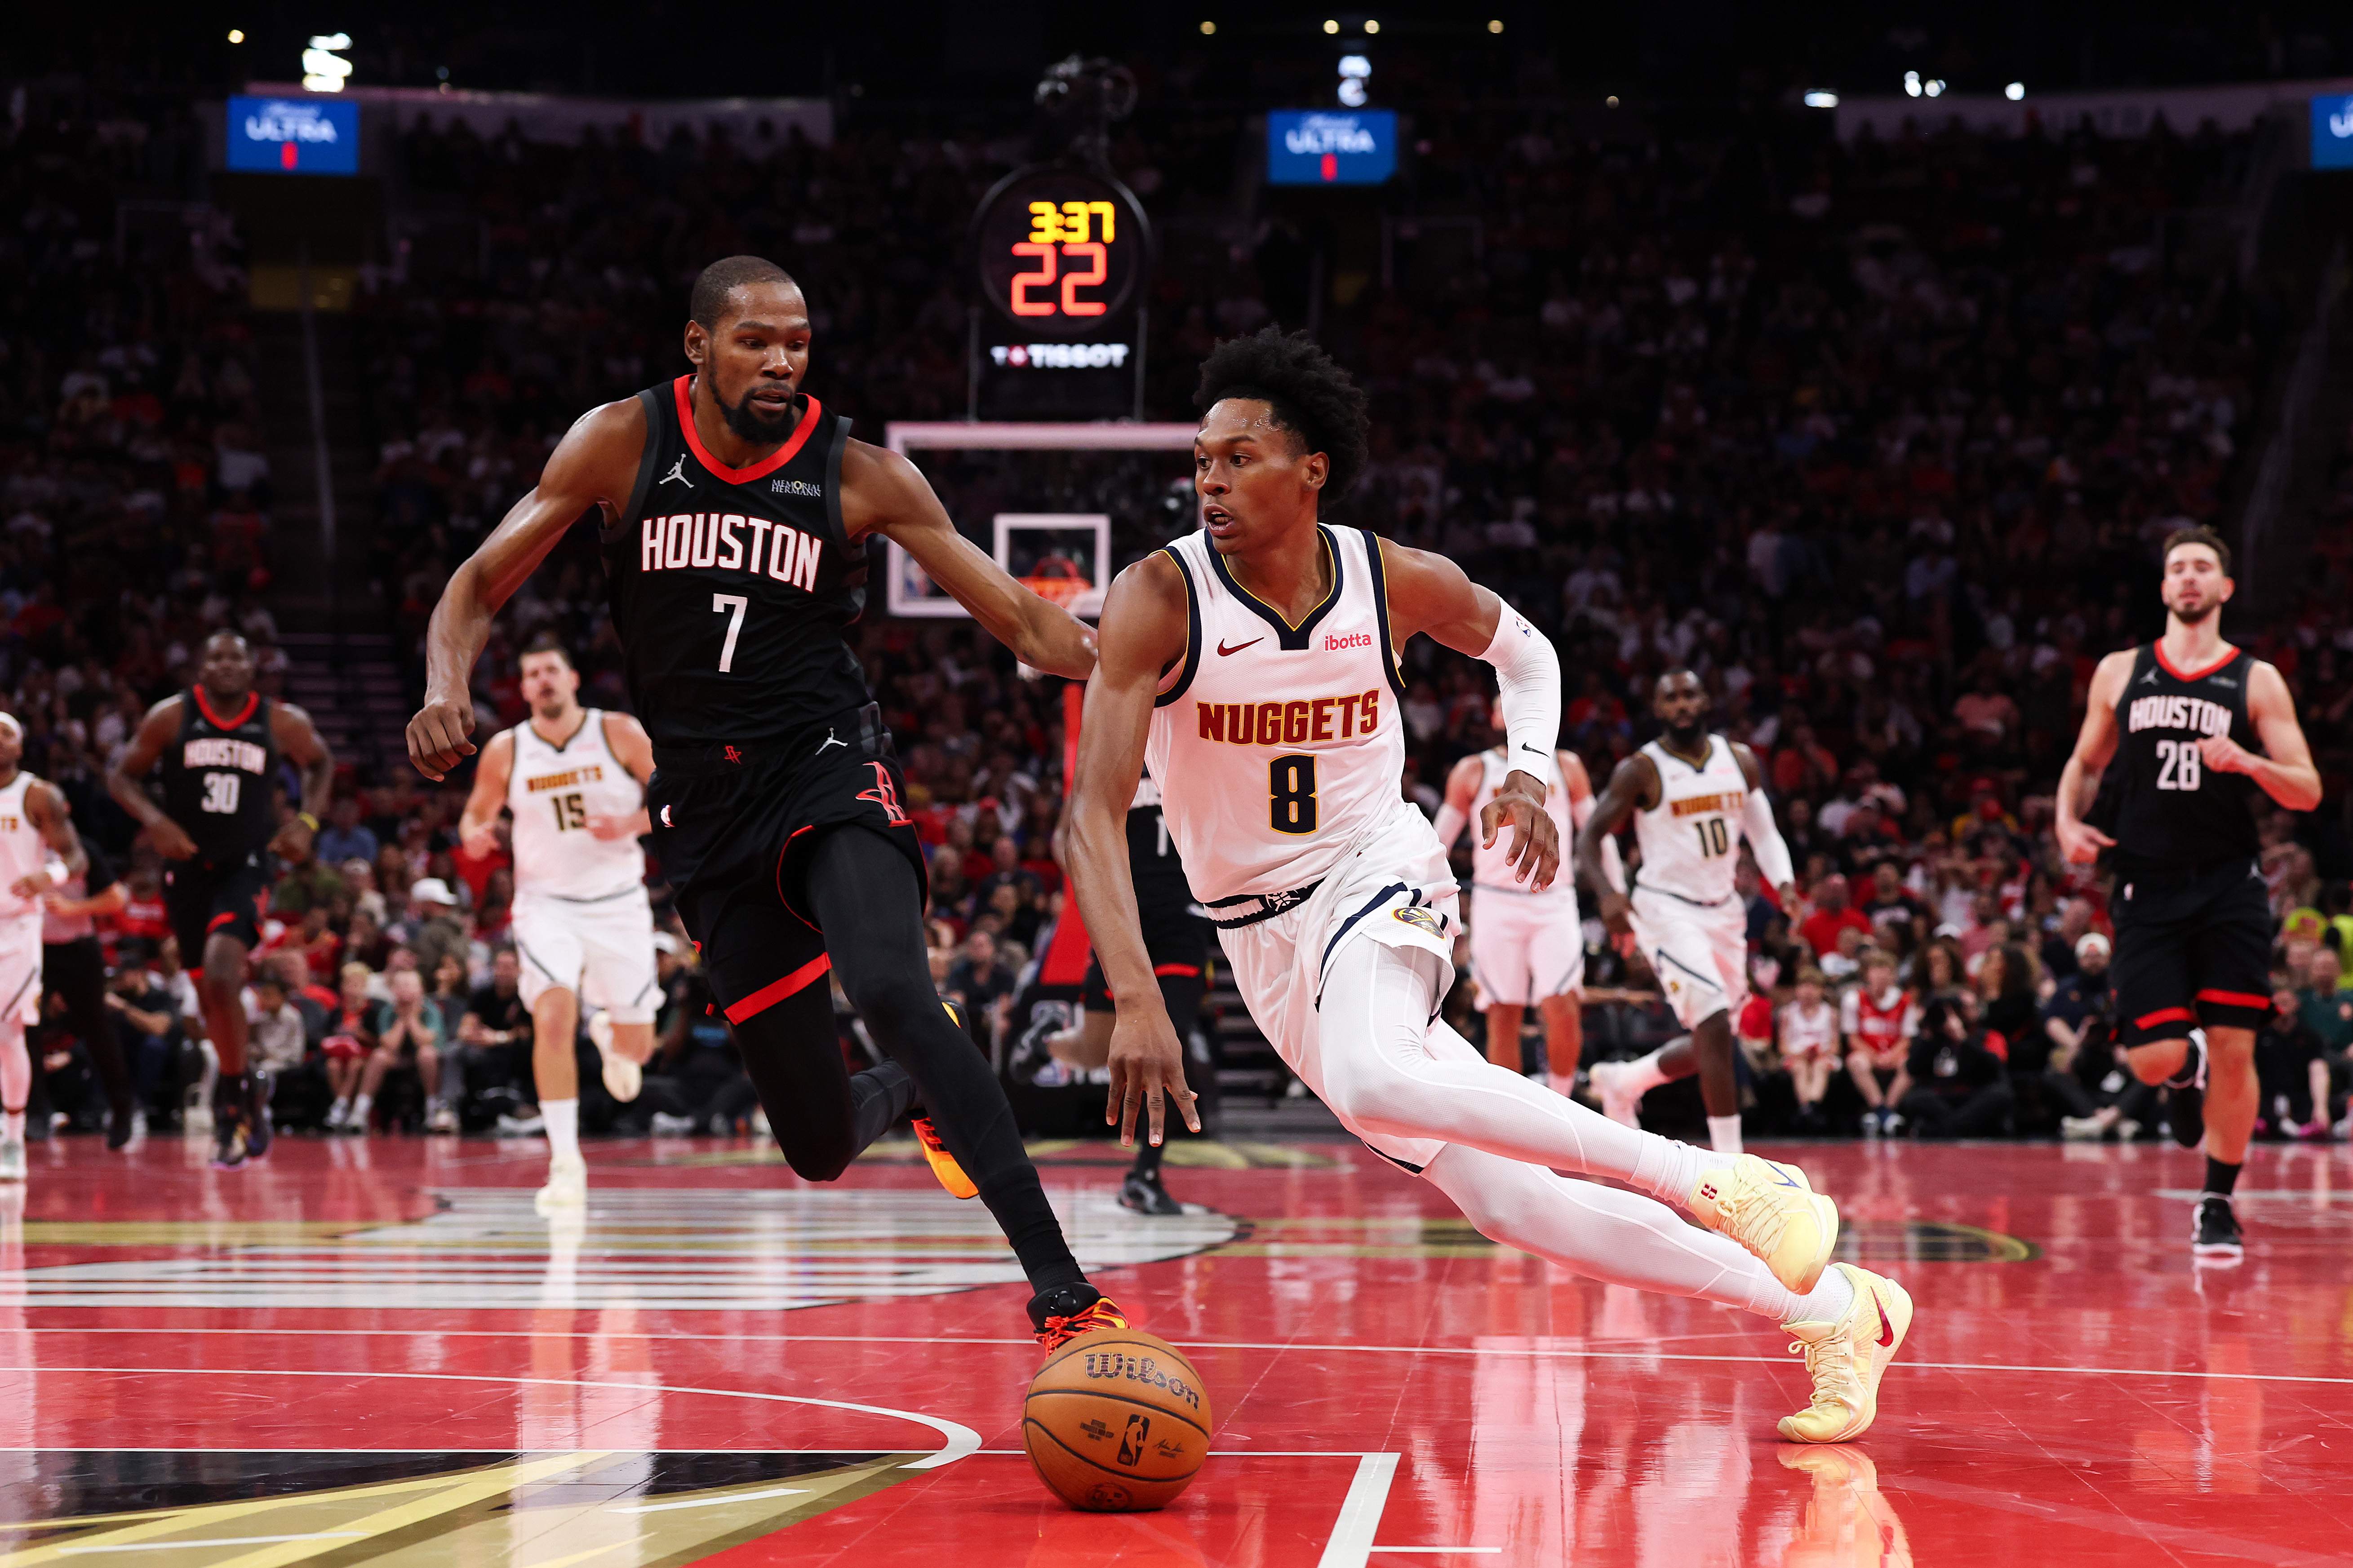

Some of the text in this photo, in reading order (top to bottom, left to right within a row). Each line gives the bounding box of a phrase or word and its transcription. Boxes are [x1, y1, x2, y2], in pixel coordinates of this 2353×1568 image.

[1029, 201, 1115, 244] 3:37
[1011, 243, 1107, 315] 22
[772, 479, 821, 492] MEMORIAL
[772, 484, 821, 496] HERMANN
[641, 513, 823, 593] HOUSTON
[713, 593, 747, 673] 7
[1324, 633, 1372, 651] ibotta
[1196, 688, 1380, 746] NUGGETS
[2128, 695, 2232, 737] HOUSTON
[2157, 740, 2201, 791] 28
[202, 772, 240, 814] 30
[552, 793, 585, 831] 15
[1268, 753, 1319, 836] 8
[1695, 817, 1727, 858] 10
[1084, 1352, 1200, 1411] Wilson
